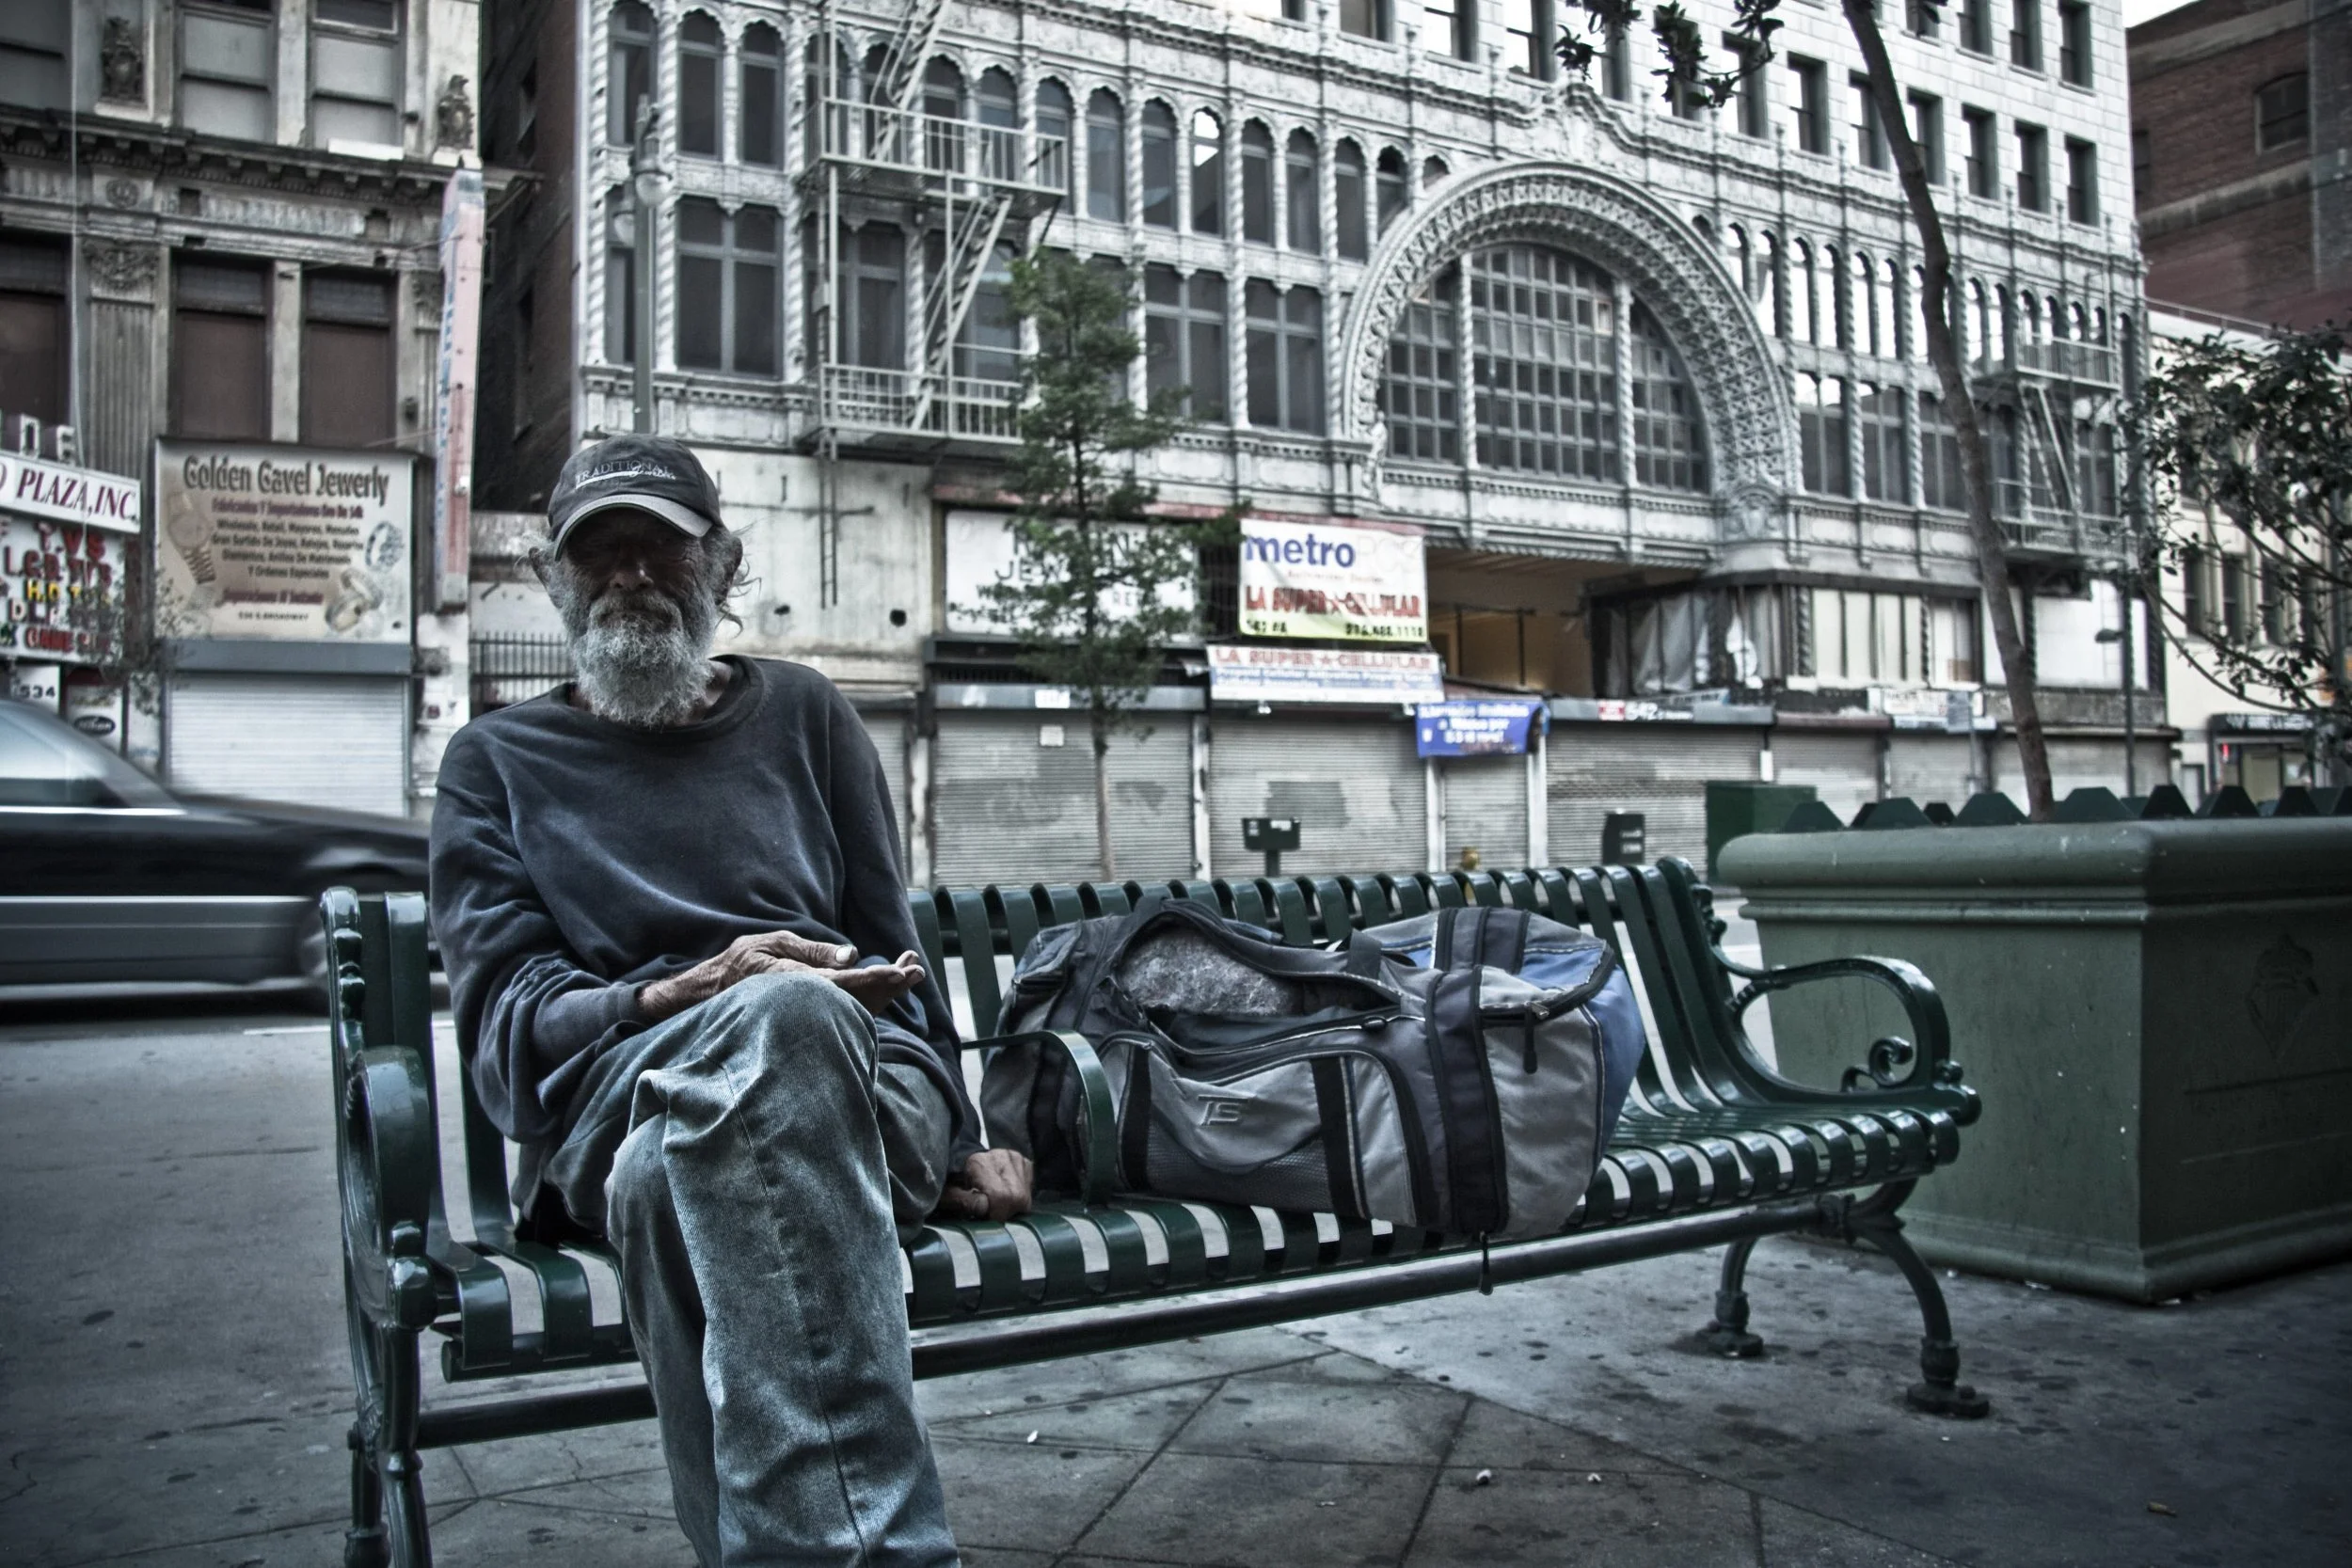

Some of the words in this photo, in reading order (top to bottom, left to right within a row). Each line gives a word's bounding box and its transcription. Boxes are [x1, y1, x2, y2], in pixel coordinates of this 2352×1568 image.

[183, 454, 252, 493] Golden
[257, 459, 312, 495] Gavel
[316, 462, 389, 507] Jewerly
[575, 459, 669, 483] TRADITIONAL
[1246, 585, 1267, 611] LA
[1272, 587, 1327, 614] SUPER
[1216, 649, 1241, 663] LA
[1249, 650, 1314, 665] SUPER
[19, 684, 56, 699] 534
